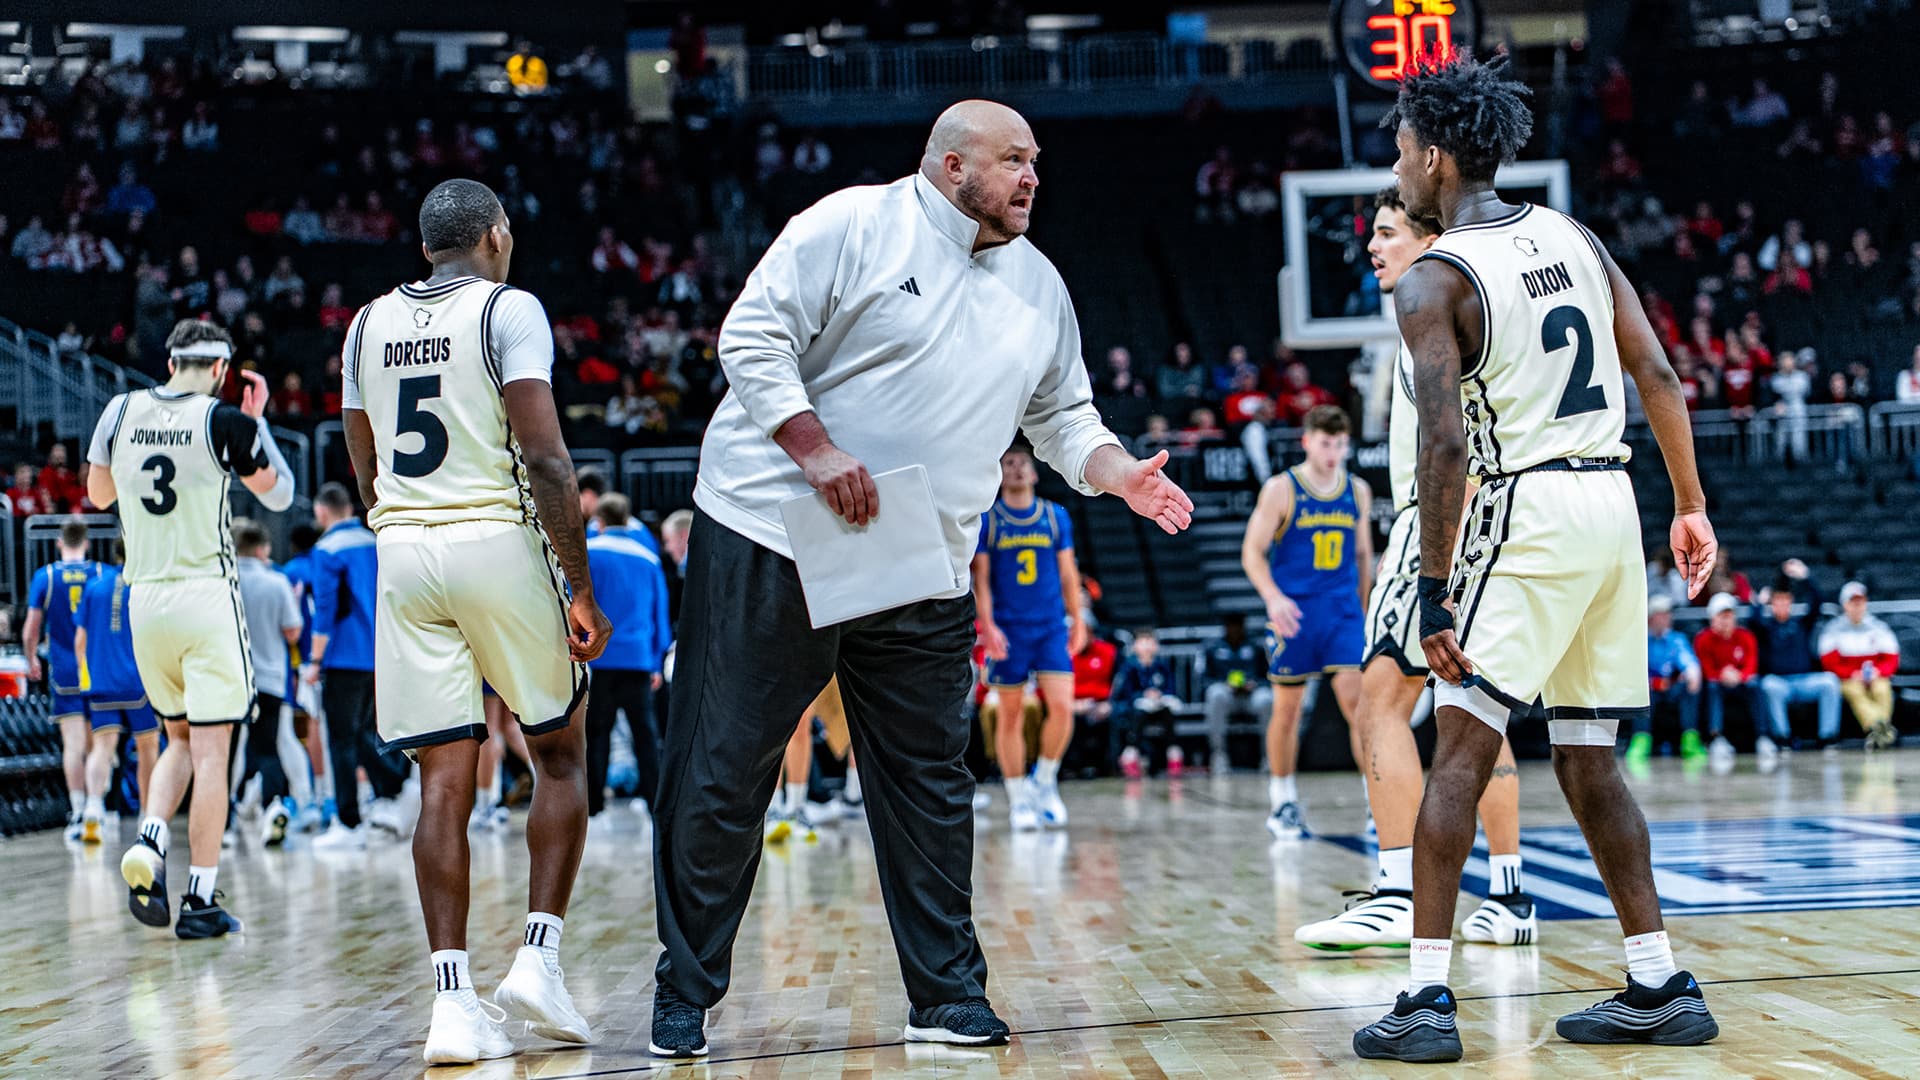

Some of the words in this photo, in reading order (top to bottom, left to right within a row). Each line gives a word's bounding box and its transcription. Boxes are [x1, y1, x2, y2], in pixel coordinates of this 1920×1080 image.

[1367, 14, 1452, 80] 30
[1521, 261, 1573, 299] DIXON
[383, 336, 451, 368] DORCEUS
[1541, 305, 1608, 419] 2
[130, 428, 192, 446] JOVANOVICH
[392, 374, 449, 478] 5
[140, 454, 177, 516] 3
[1017, 549, 1037, 585] 3
[1311, 530, 1344, 570] 10
